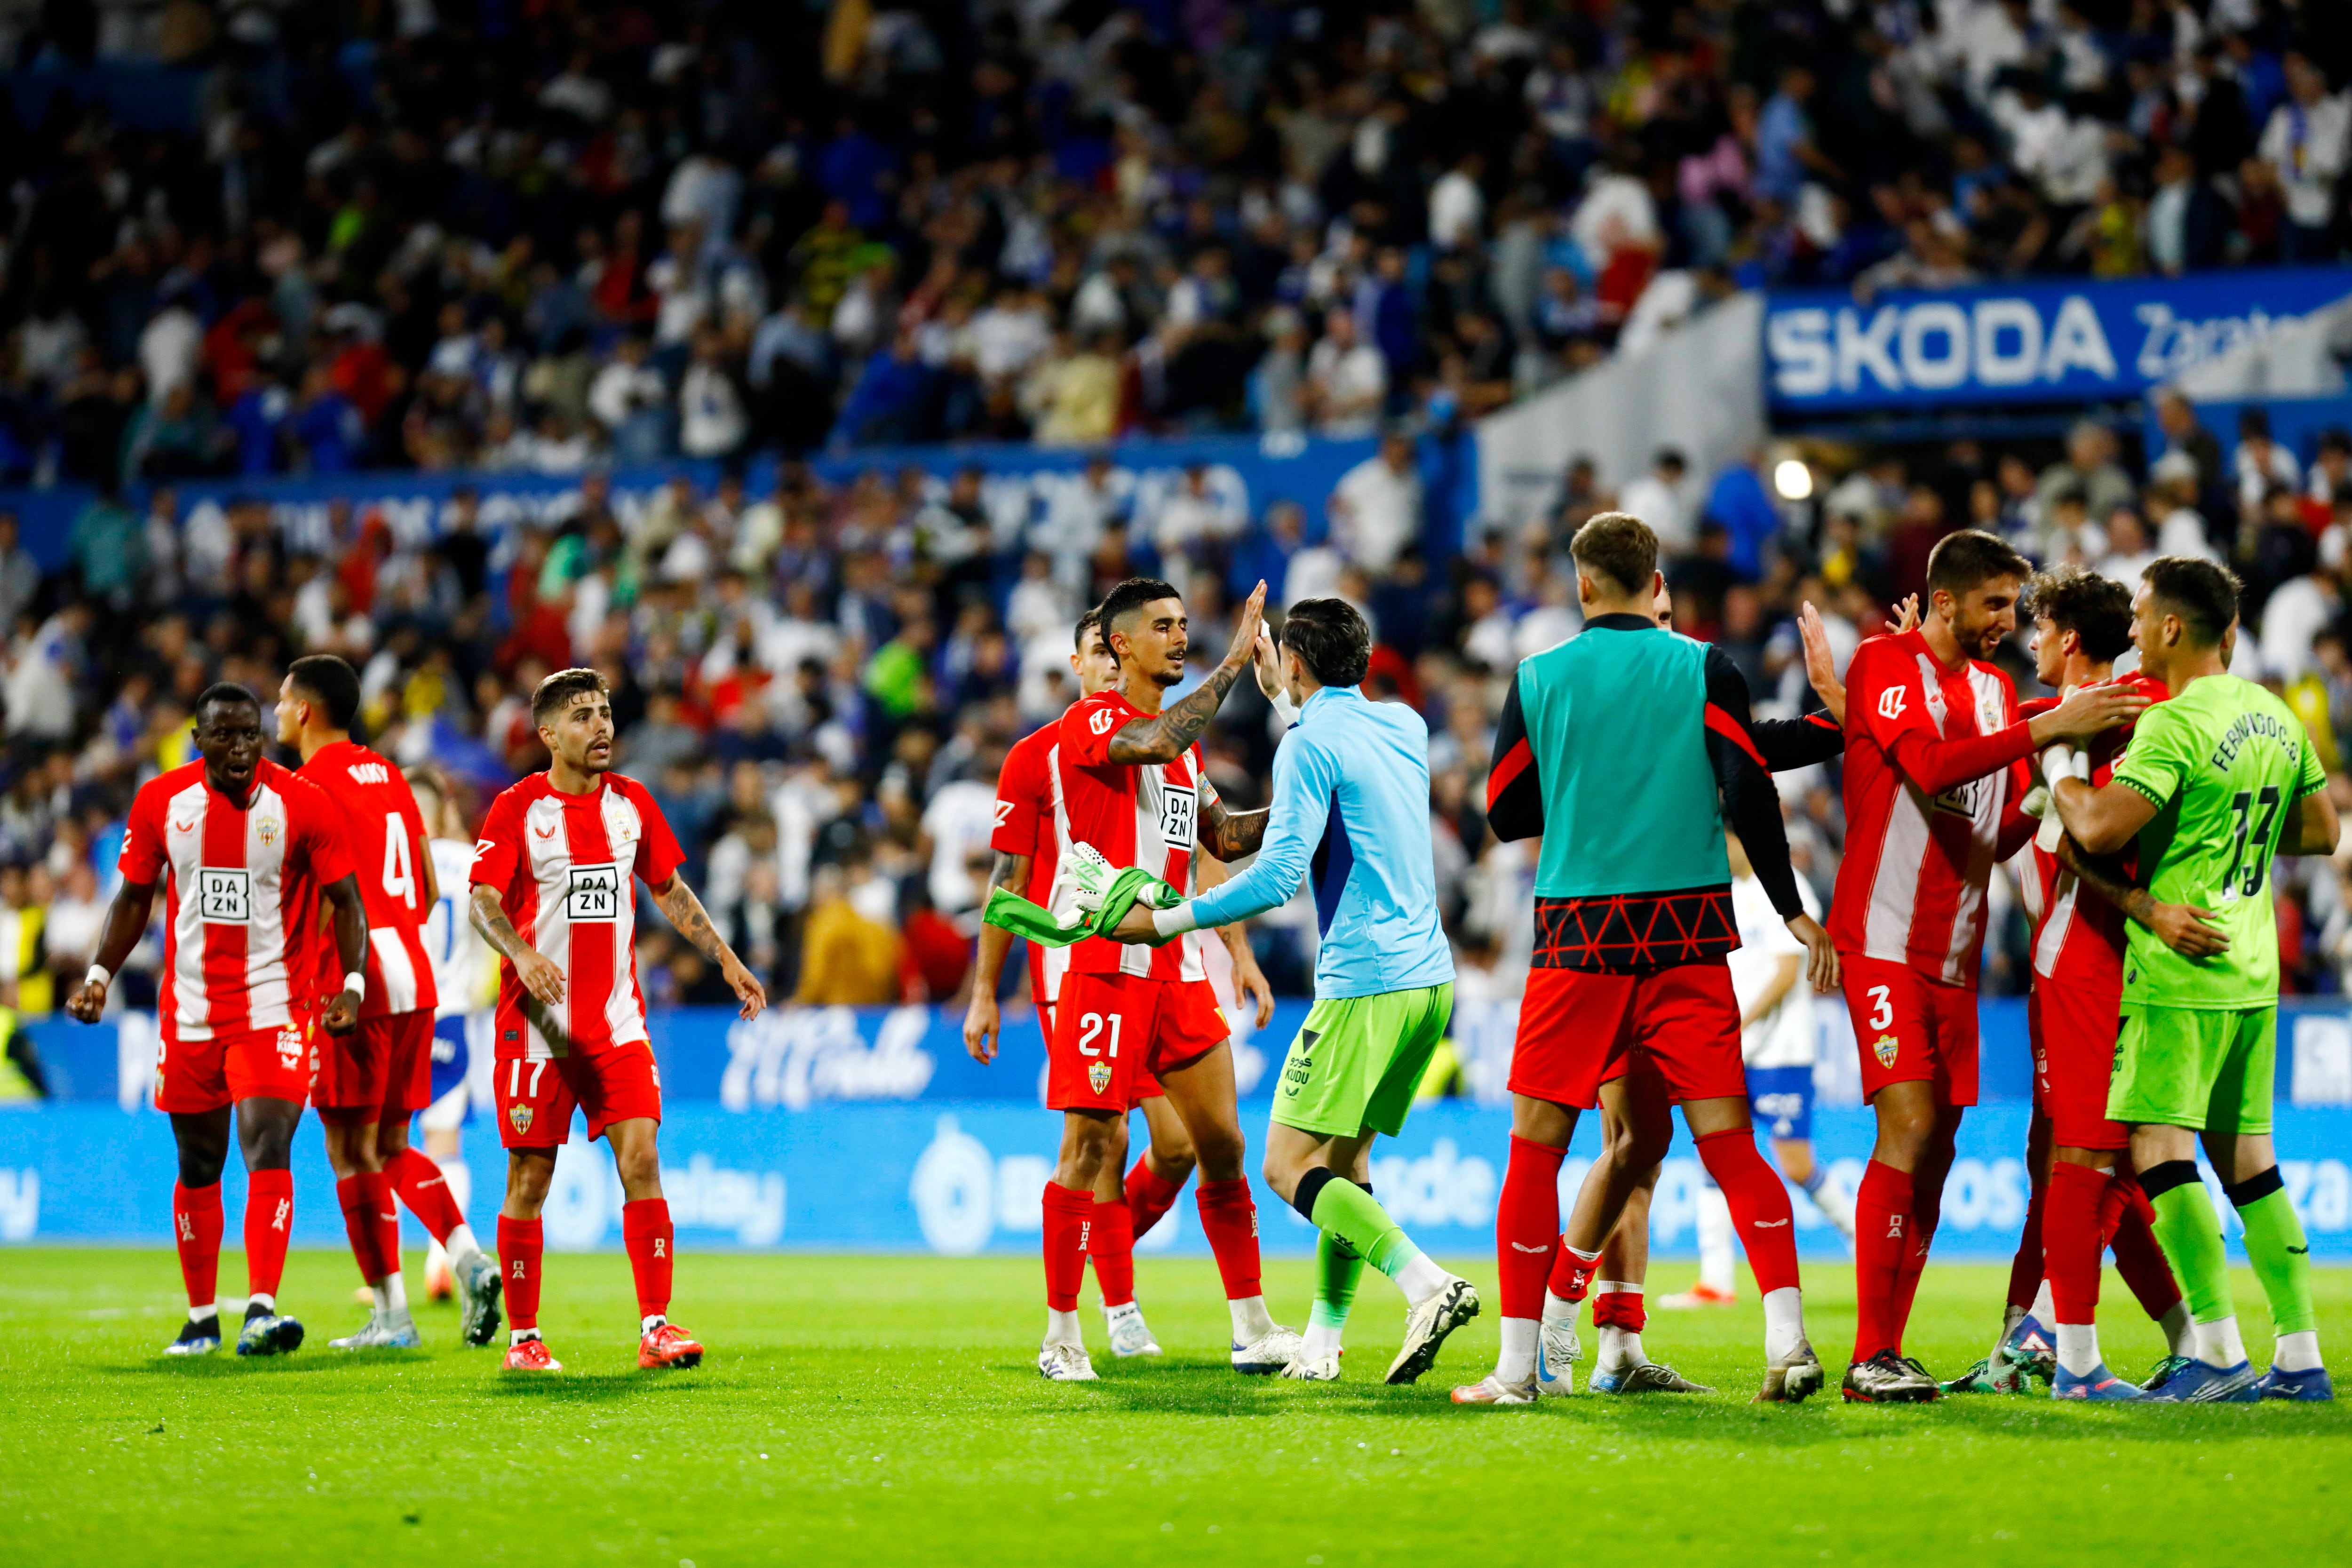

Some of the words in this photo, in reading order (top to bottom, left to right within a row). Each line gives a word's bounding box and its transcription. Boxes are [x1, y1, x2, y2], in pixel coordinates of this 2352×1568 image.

[1770, 296, 2116, 394] SKODA
[1171, 798, 1187, 817] DA
[1169, 819, 1186, 837] ZN
[2223, 785, 2280, 899] 13
[382, 811, 417, 909] 4
[213, 879, 237, 893] DA
[580, 876, 607, 890] DA
[213, 898, 237, 911] ZN
[580, 894, 604, 909] ZN
[1867, 985, 1893, 1030] 3
[1079, 1012, 1121, 1058] 21
[509, 1058, 547, 1098] 17
[1285, 1068, 1309, 1084] KUDU
[178, 1212, 196, 1242] UDA
[271, 1198, 290, 1232] UDA
[1250, 1210, 1259, 1239] UDA
[1078, 1221, 1091, 1251] UDA
